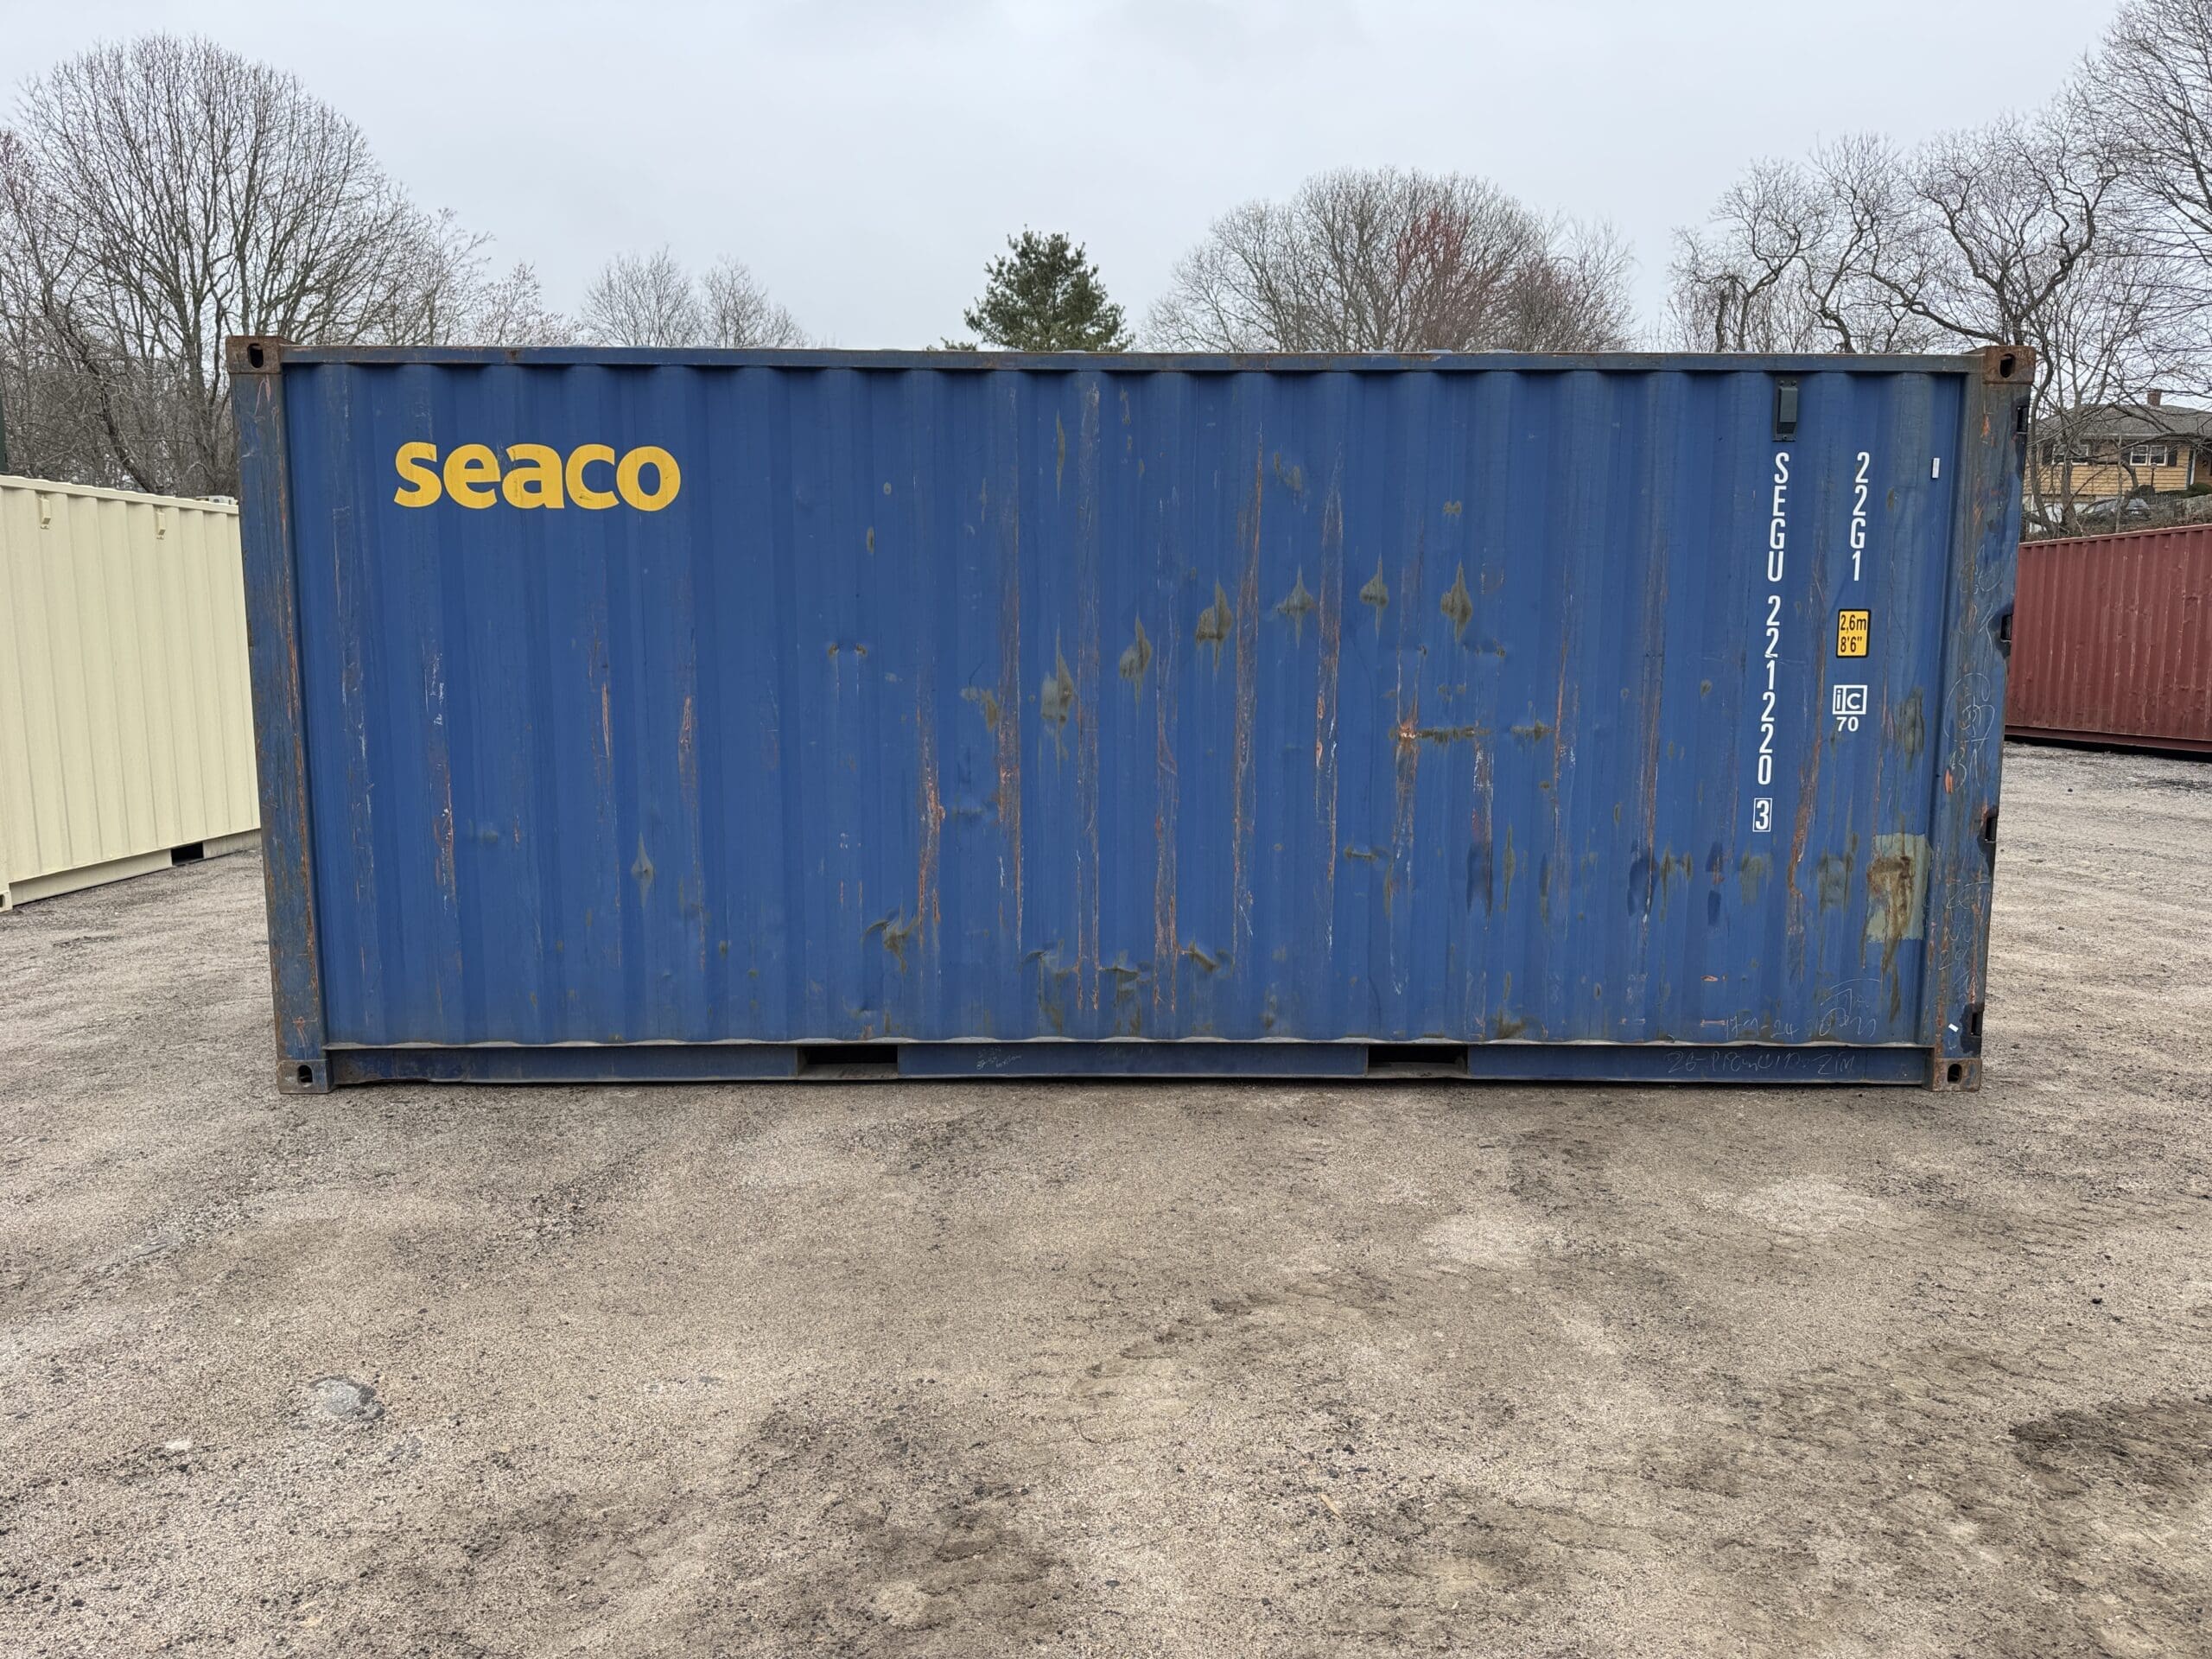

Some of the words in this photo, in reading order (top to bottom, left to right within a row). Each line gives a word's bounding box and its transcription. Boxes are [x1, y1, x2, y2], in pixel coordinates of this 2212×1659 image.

[393, 441, 682, 512] seaco
[1766, 451, 1790, 582] SEGU
[1849, 451, 1871, 582] 22G1
[1757, 594, 1782, 785] 221220
[1836, 715, 1859, 732] 70
[1755, 799, 1770, 830] 3
